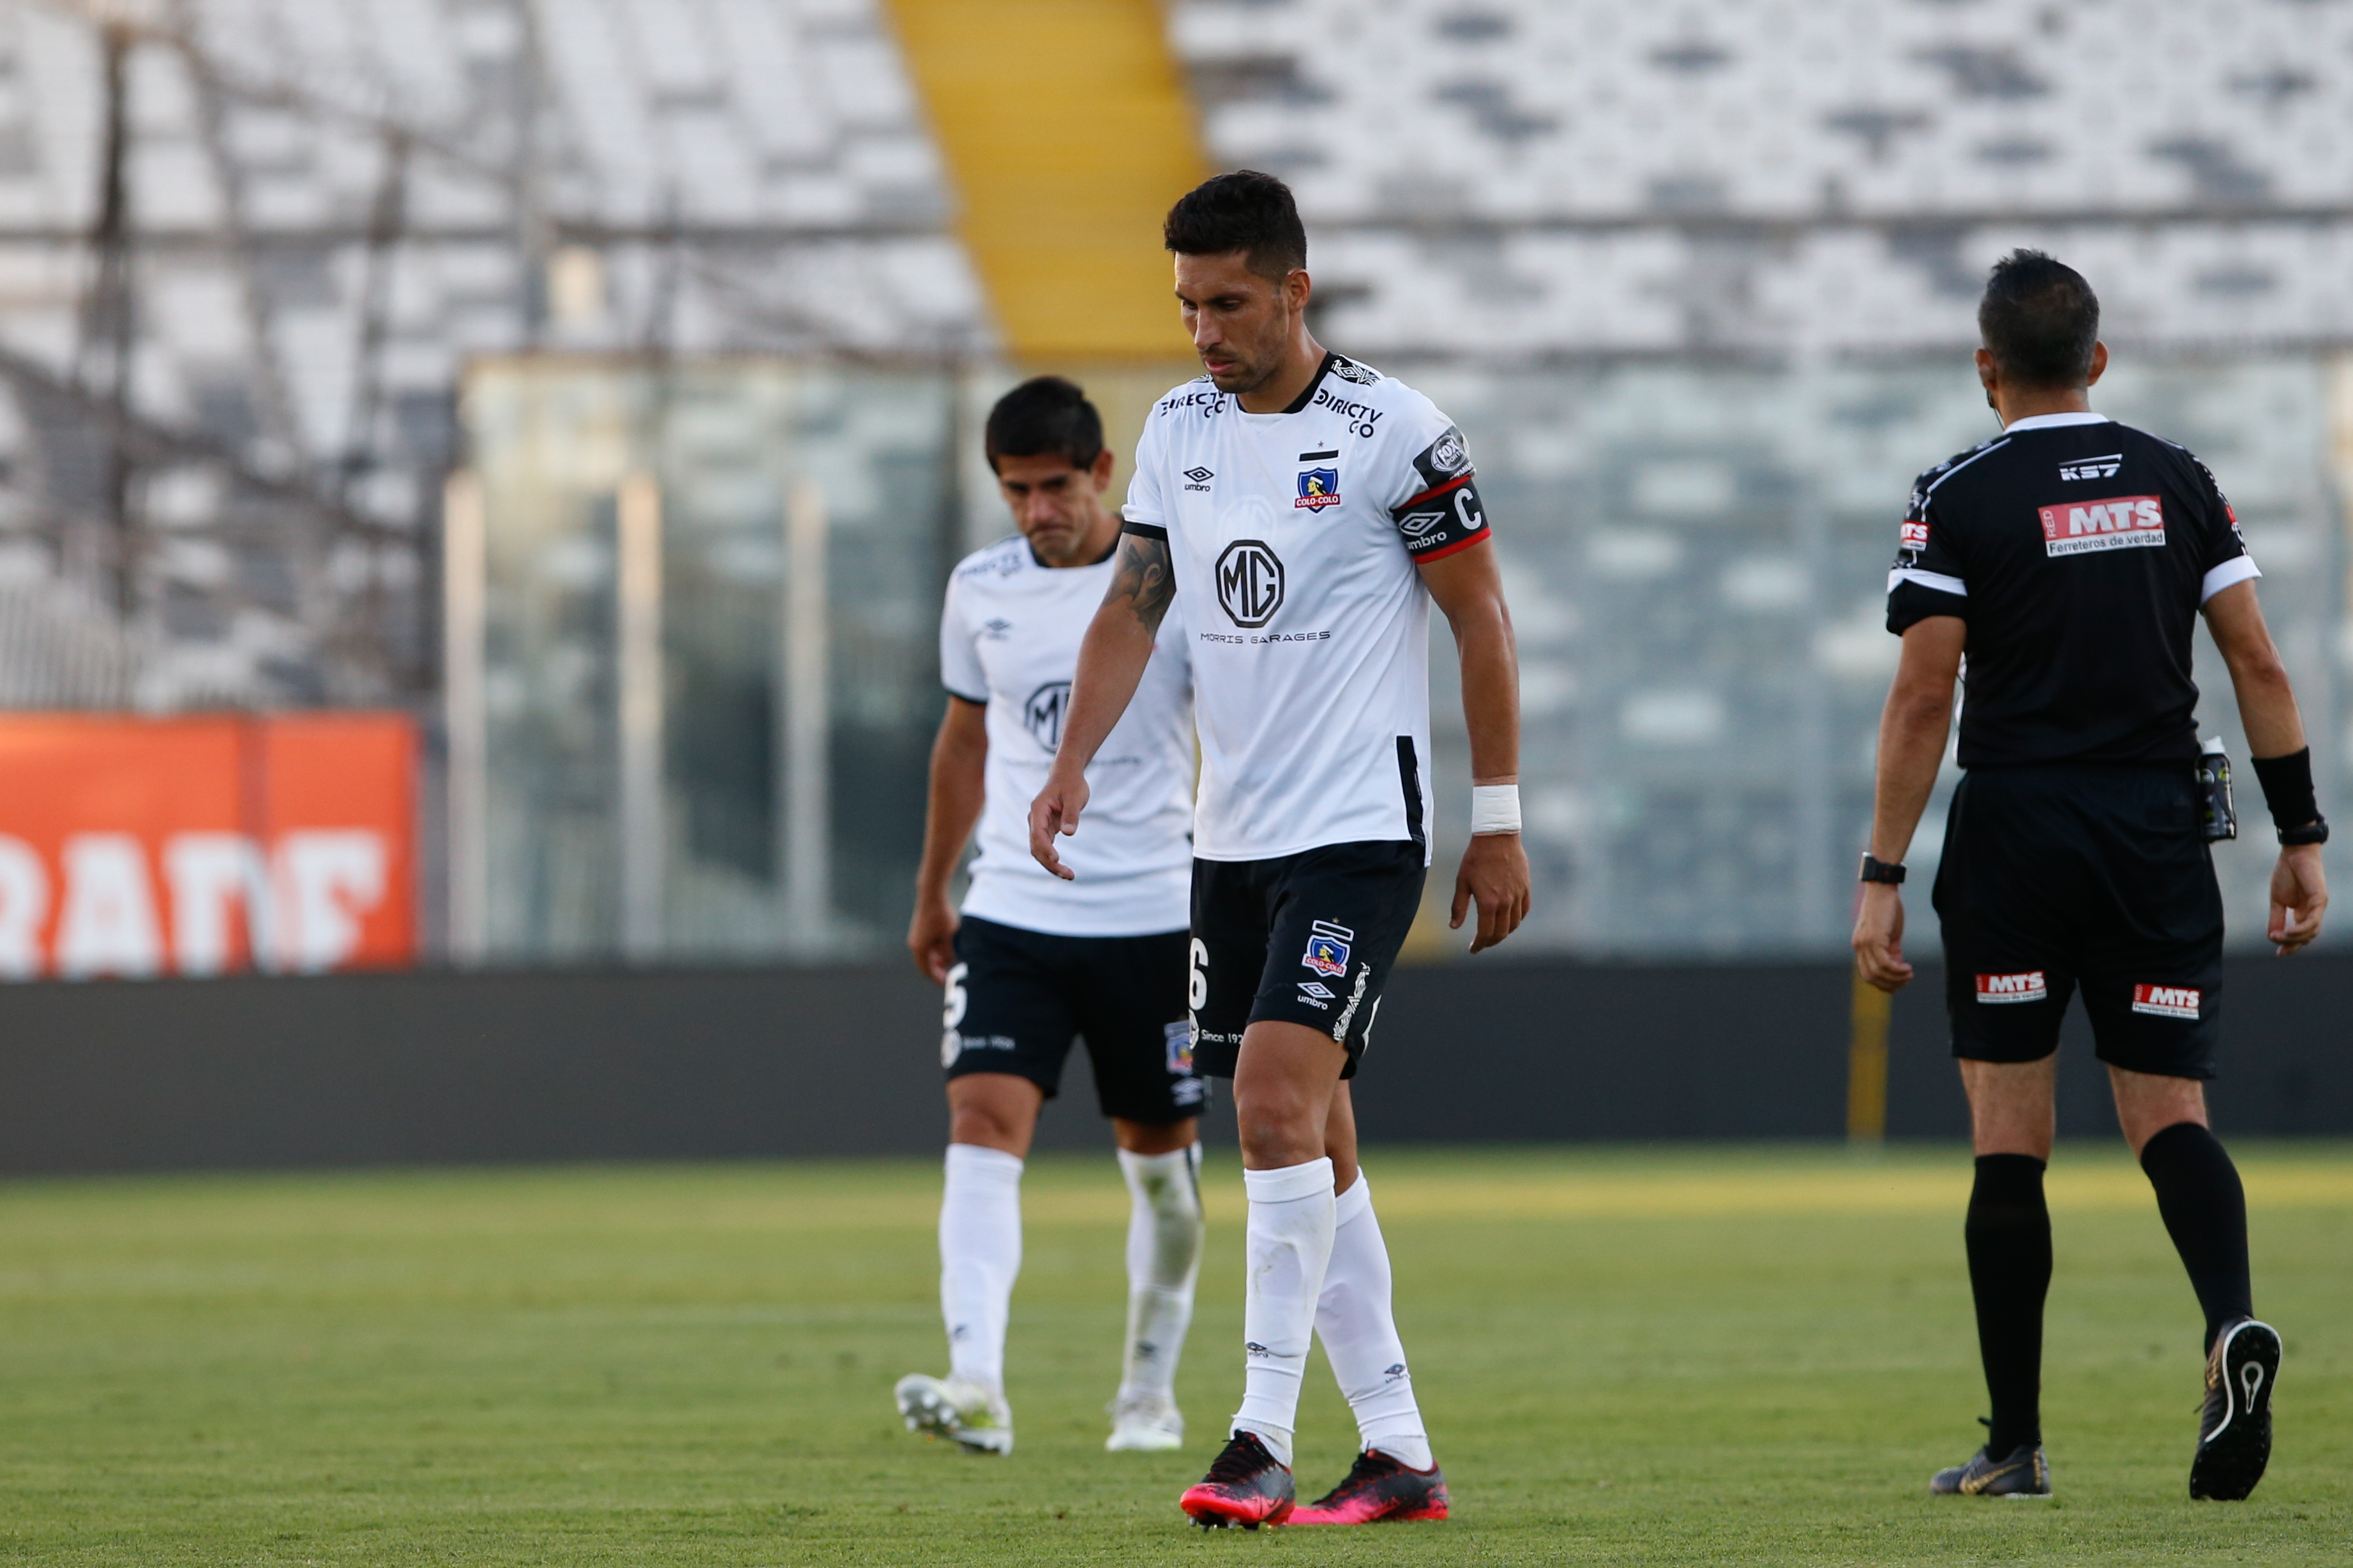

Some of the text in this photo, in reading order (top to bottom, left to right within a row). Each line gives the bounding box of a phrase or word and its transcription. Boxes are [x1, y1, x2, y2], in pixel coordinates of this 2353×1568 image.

[1313, 388, 1383, 423] DIRECTV
[1436, 438, 1460, 467] FOX
[2059, 463, 2121, 481] KS7
[1184, 483, 1211, 492] umbro
[1454, 488, 1482, 530] C
[2069, 500, 2162, 535] MTS
[2049, 532, 2164, 554] Ferreteros de verdad
[1223, 550, 1276, 618] MG
[1200, 631, 1330, 644] MORRIS GARAGES
[1189, 937, 1209, 1011] 6
[1988, 971, 2045, 992] MTS
[1297, 995, 1328, 1010] umbro
[2149, 987, 2200, 1007] MTS
[1201, 1029, 1224, 1042] Since
